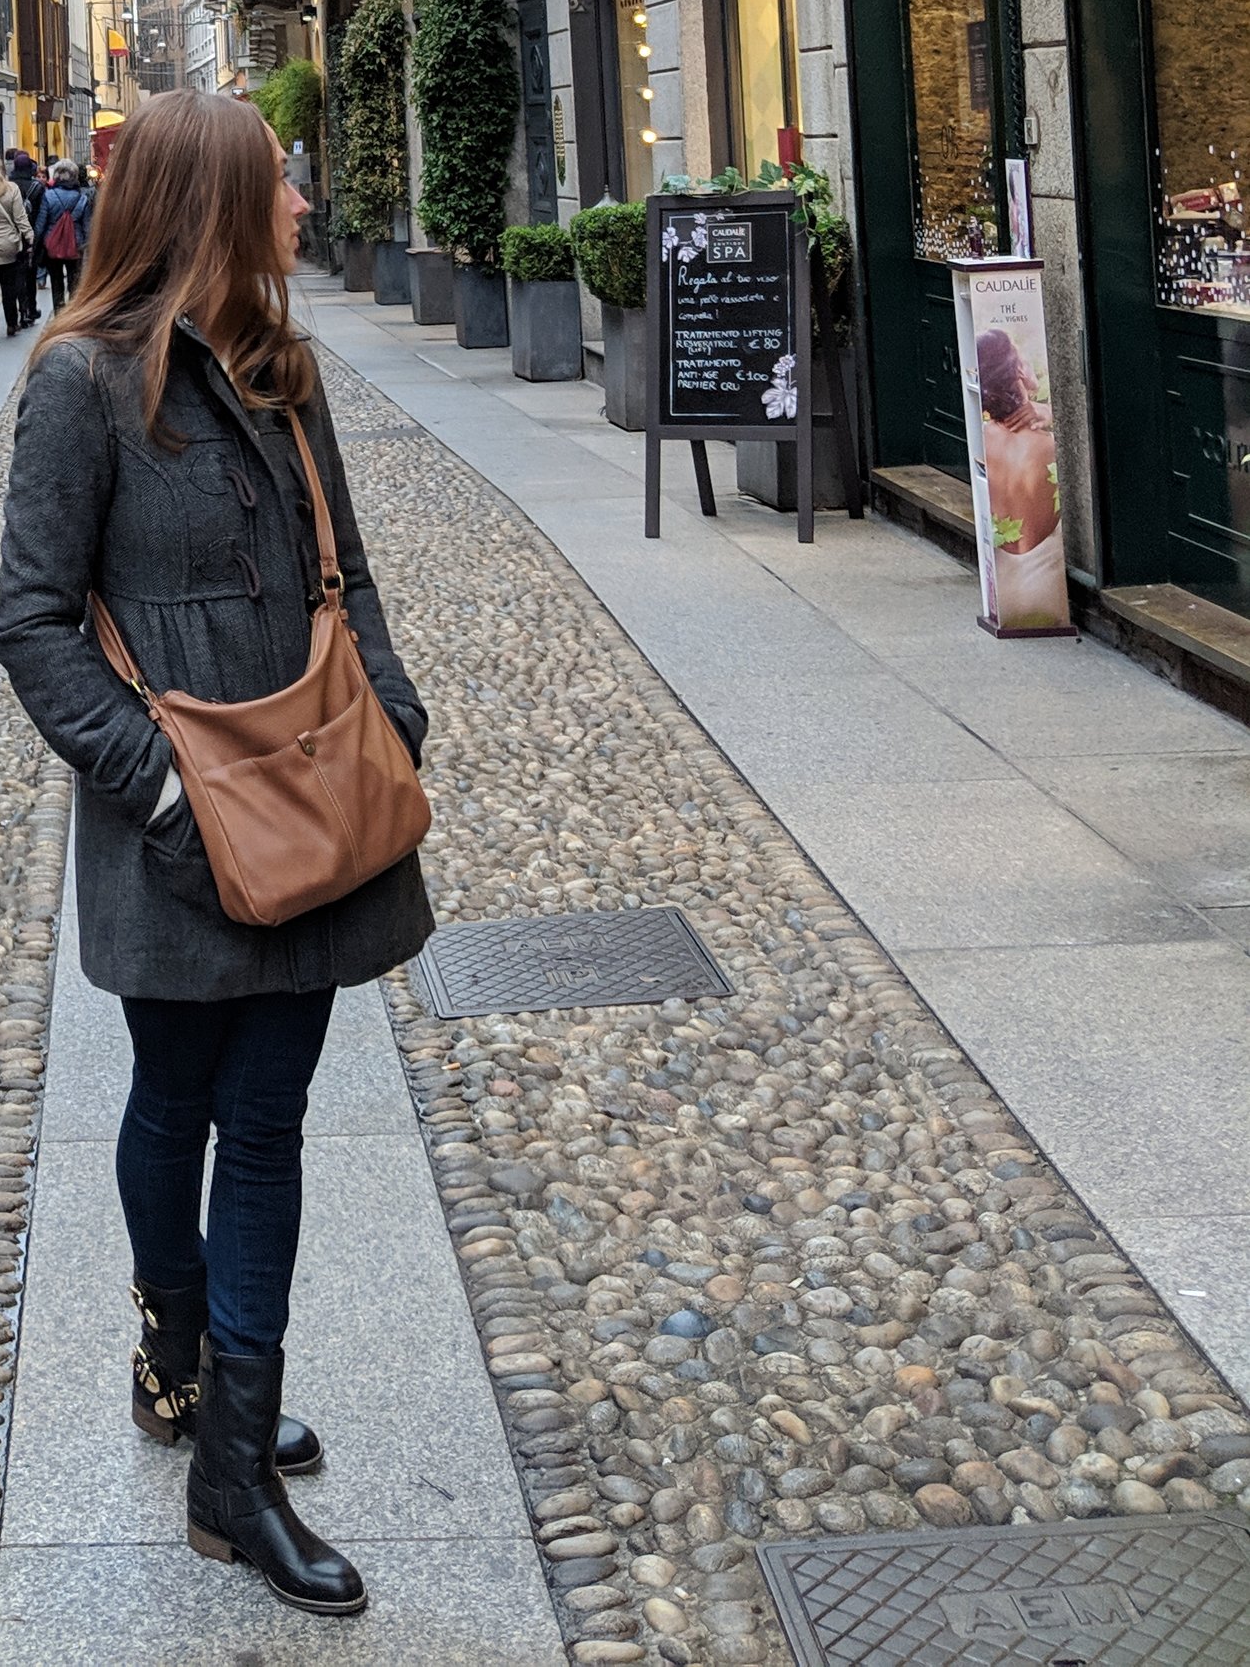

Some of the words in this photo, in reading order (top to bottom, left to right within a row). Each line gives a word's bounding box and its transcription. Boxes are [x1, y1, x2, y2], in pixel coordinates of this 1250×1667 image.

[713, 246, 746, 259] SPA
[678, 265, 718, 294] Regala
[1000, 303, 1017, 314] THÉ
[1006, 315, 1029, 323] VIGNES
[674, 330, 740, 339] TRATTAMENTO
[742, 328, 783, 338] LIFTING
[748, 339, 760, 349] €
[763, 337, 781, 350] 80
[676, 359, 741, 369] TRATTAMENTO
[678, 379, 717, 391] PREMIER
[720, 382, 740, 391] CRU
[963, 1586, 1144, 1635] AEM
